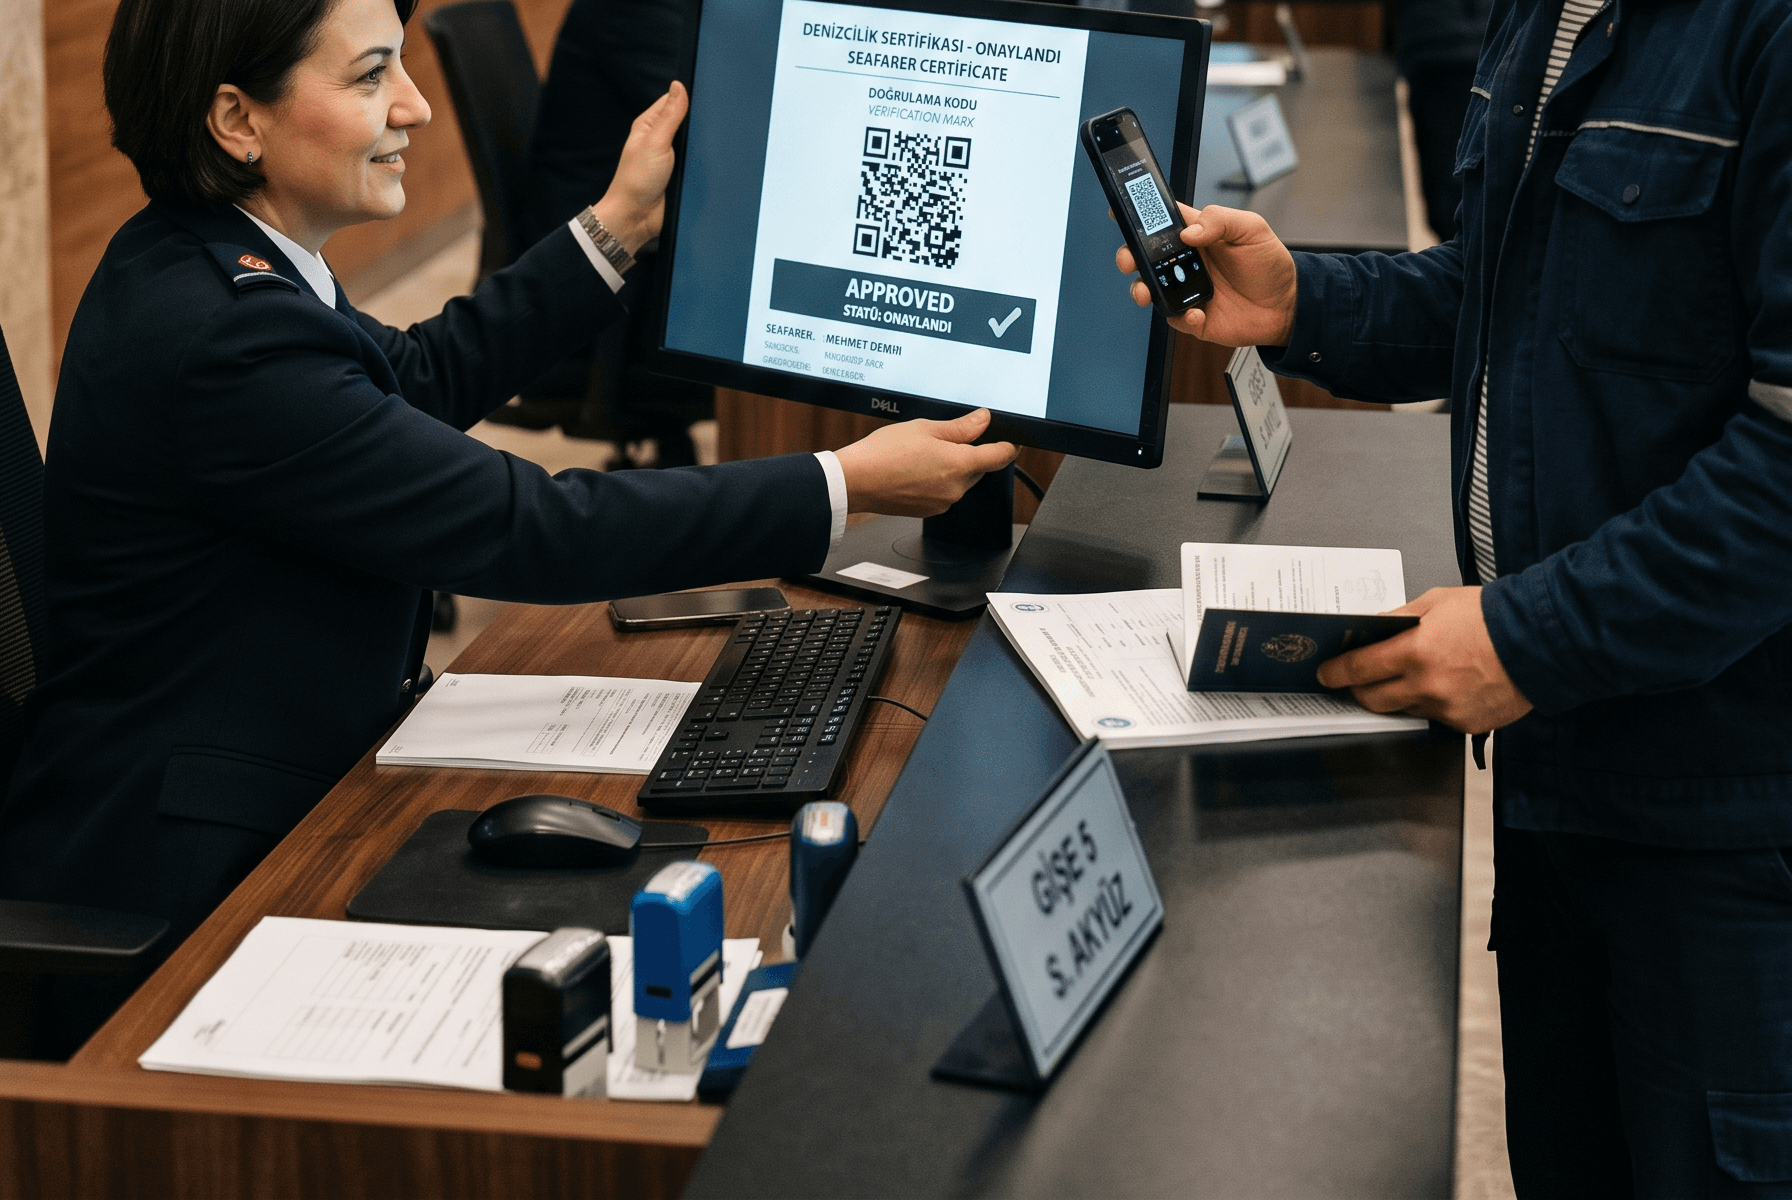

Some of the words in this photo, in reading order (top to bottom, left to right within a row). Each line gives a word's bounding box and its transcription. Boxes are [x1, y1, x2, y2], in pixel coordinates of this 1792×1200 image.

[803, 22, 878, 44] DENİZCİLİK
[881, 31, 964, 53] SERTİFİKASI
[975, 41, 1061, 64] ONAYLANDI
[848, 50, 917, 71] SEAFARER
[868, 86, 941, 107] DOĞRULAMA
[944, 96, 977, 111] KODU
[868, 104, 941, 124] VERIFICATION
[845, 278, 955, 314] APPROVED
[883, 311, 952, 333] ONAYLANDI
[871, 397, 900, 413] DELL
[1031, 834, 1084, 917] GİŞE
[1078, 819, 1099, 864] 5
[1067, 871, 1134, 978] AKYÜZ
